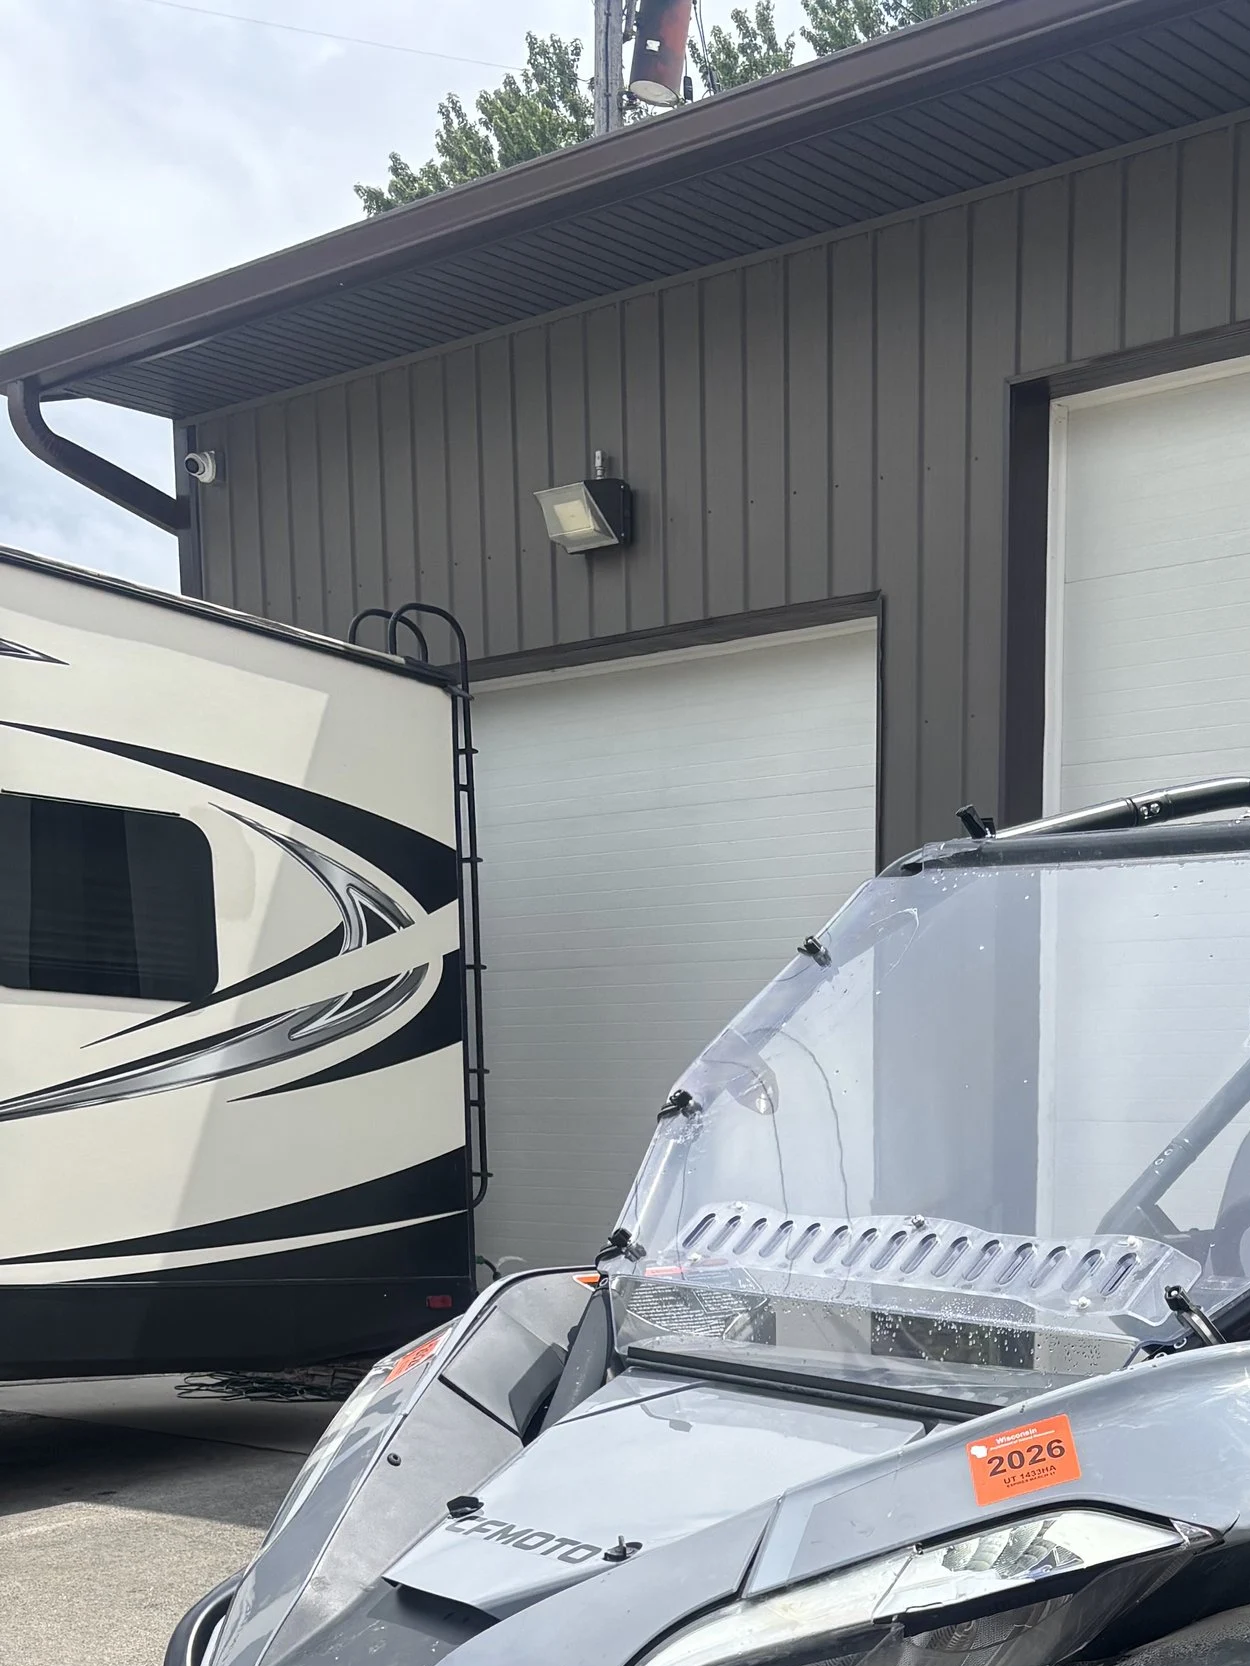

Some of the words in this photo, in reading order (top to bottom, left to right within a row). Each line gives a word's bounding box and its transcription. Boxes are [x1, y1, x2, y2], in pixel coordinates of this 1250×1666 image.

[995, 1427, 1038, 1445] Wisconsin
[986, 1438, 1066, 1477] 2026
[1003, 1475, 1017, 1485] UT
[444, 1515, 603, 1565] CFMOTO
